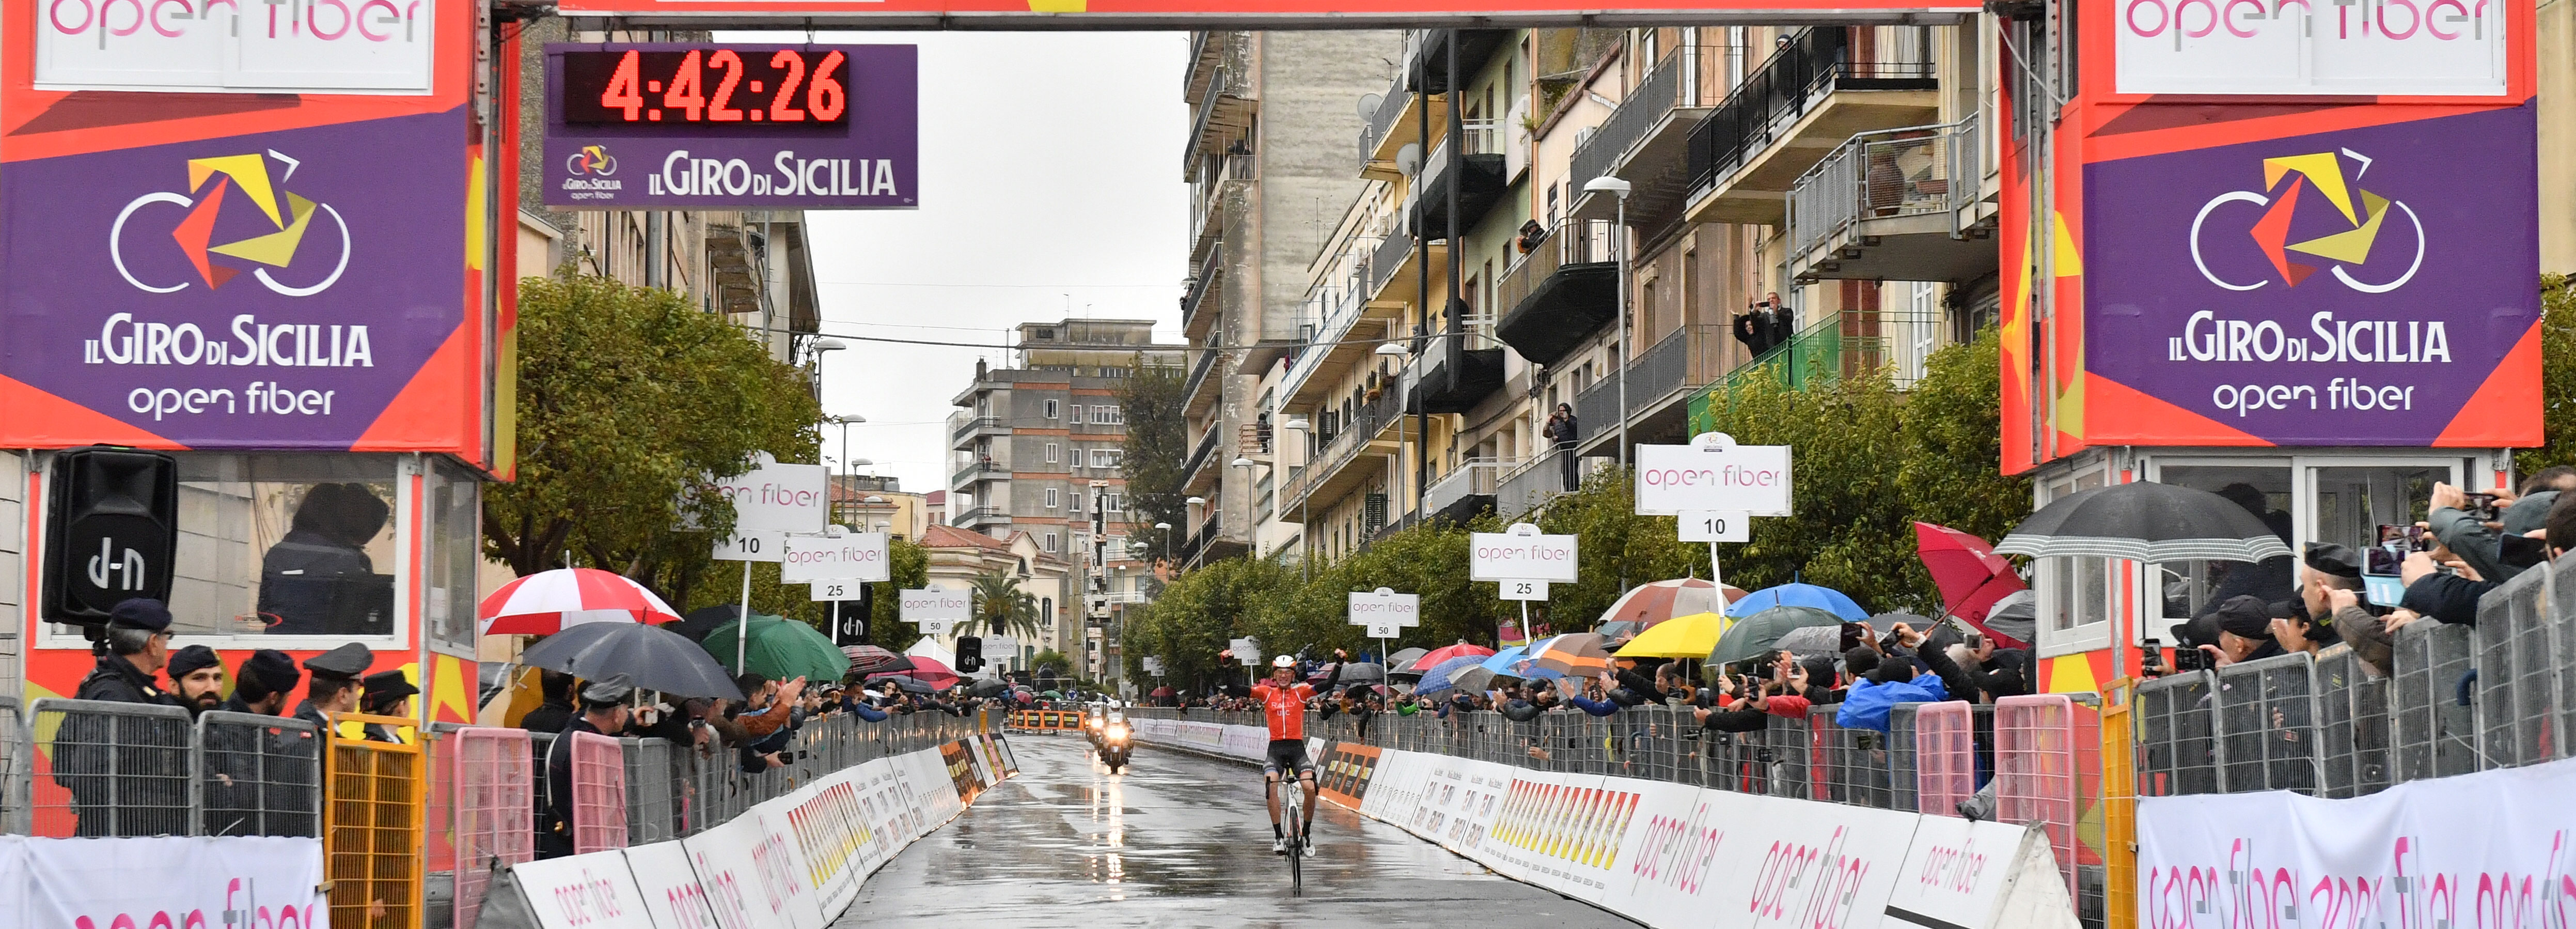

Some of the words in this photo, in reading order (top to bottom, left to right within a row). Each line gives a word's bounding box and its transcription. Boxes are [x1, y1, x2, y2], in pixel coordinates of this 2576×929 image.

[602, 50, 845, 121] 4:42:26
[664, 150, 751, 195] GIRO
[774, 151, 897, 196] SICILIA
[102, 313, 205, 365] GIRO
[230, 315, 373, 367] SICILIA
[2185, 311, 2284, 362] GIRO
[2311, 311, 2452, 362] SICILIA
[129, 386, 234, 421] open
[246, 382, 335, 415] fiber
[2213, 384, 2316, 417] open
[2328, 378, 2415, 411] fiber
[1646, 469, 1714, 490] open
[1723, 465, 1780, 486] fiber
[761, 484, 819, 507] fiber
[1704, 519, 1725, 534] 10
[739, 537, 760, 553] 10
[1478, 548, 1525, 562] open
[1531, 545, 1570, 560] fiber
[788, 551, 836, 566] open
[842, 547, 881, 561] fiber
[827, 585, 843, 596] 25
[1516, 583, 1532, 594] 25
[904, 600, 936, 610] open
[940, 598, 966, 608] fiber
[1353, 603, 1385, 614] open
[1389, 602, 1414, 613] fiber
